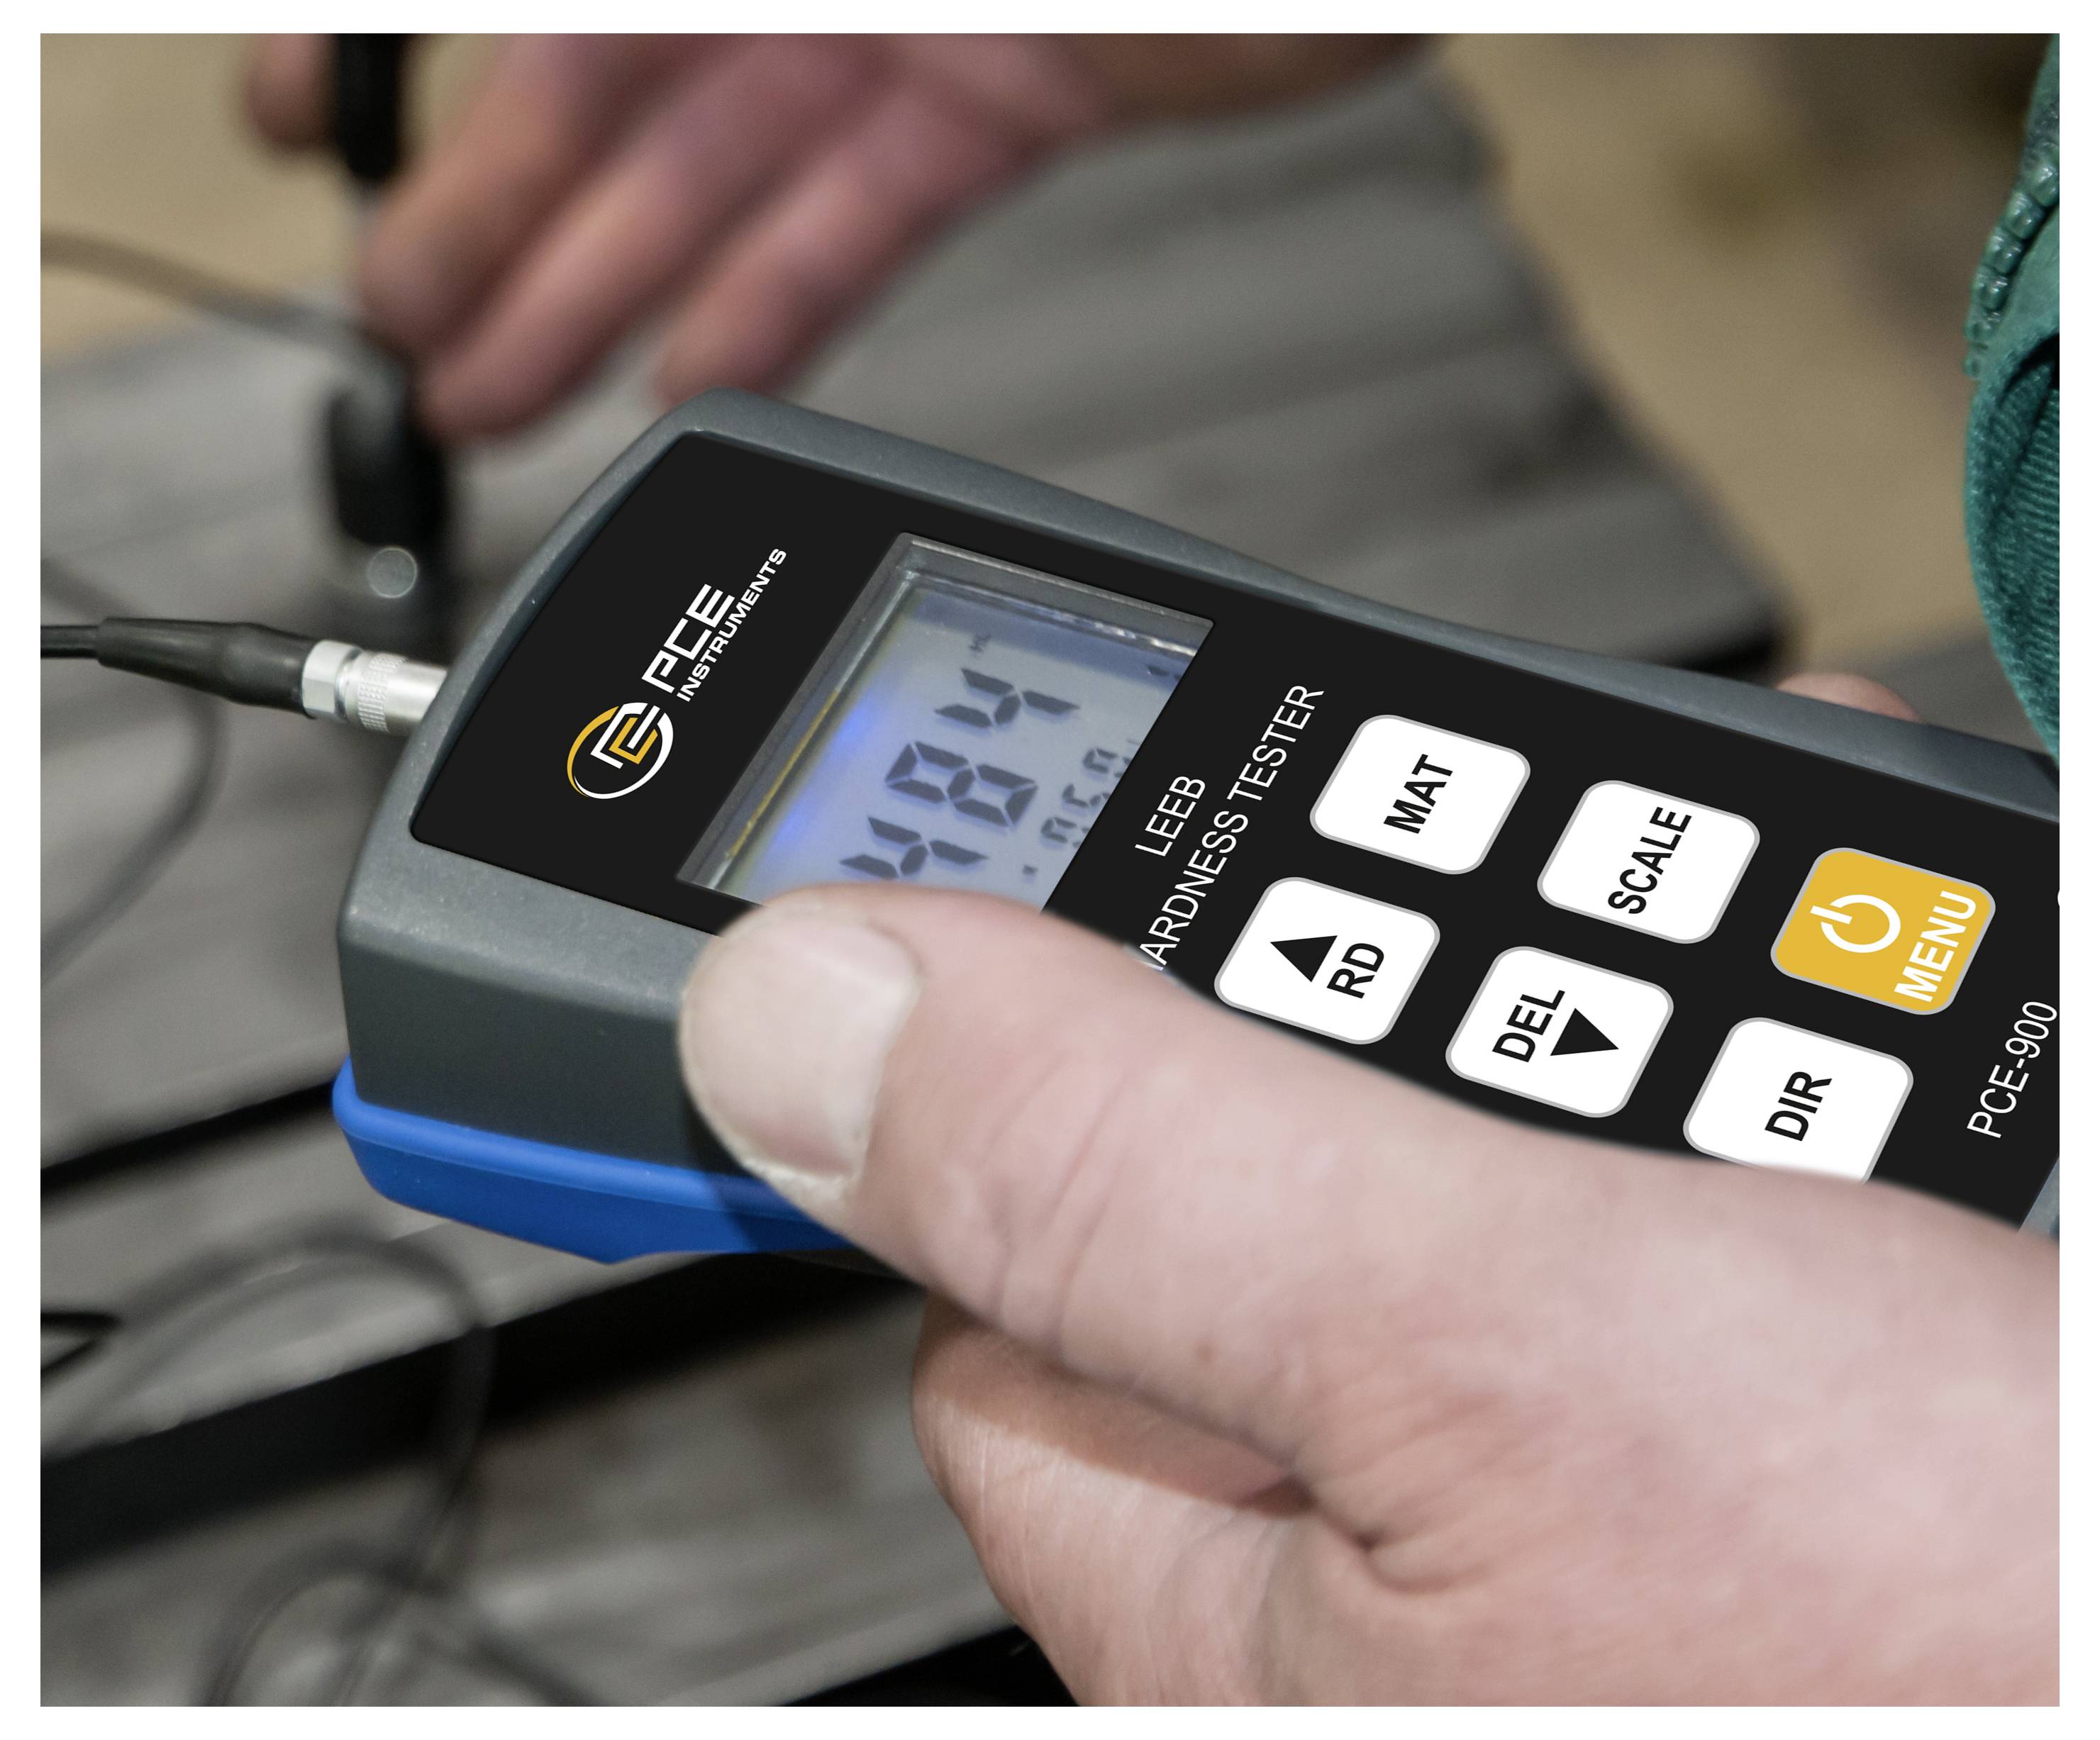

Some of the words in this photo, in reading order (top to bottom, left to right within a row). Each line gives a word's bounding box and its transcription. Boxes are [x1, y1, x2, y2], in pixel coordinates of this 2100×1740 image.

[642, 584, 735, 693] PCE
[677, 548, 787, 702] INSTRUMENTS
[840, 668, 1081, 879] 484
[1135, 776, 1206, 857] LEEB
[1383, 754, 1453, 834] MAT
[1139, 810, 1248, 971] ARDNESS
[1227, 685, 1325, 801] TESTER
[1608, 806, 1692, 914] SCALE
[1326, 943, 1384, 999] RD
[1894, 890, 1977, 1003] MENU
[1491, 990, 1565, 1063] DEL
[1966, 1001, 2057, 1139] PCE-900
[1765, 1071, 1833, 1142] DIR
